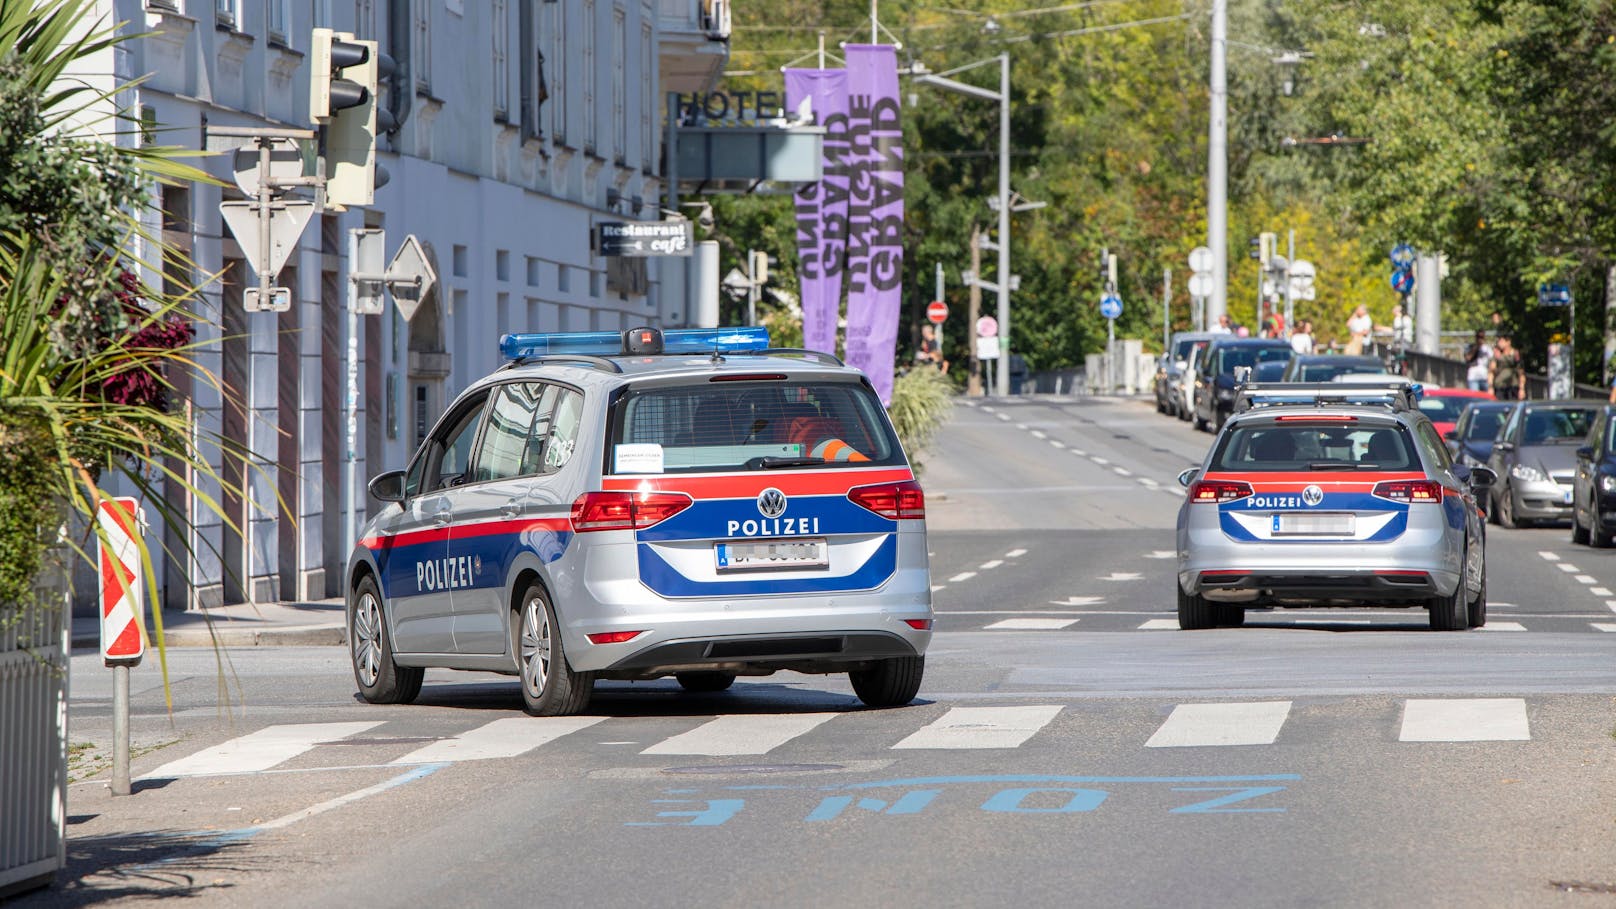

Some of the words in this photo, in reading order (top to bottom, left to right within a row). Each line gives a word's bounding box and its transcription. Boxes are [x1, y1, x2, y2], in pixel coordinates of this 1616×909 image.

[603, 224, 685, 236] Restaurant
[651, 236, 685, 254] café
[1247, 497, 1300, 507] POLIZEI
[727, 517, 819, 536] POLIZEI
[416, 556, 473, 592] POLIZEI
